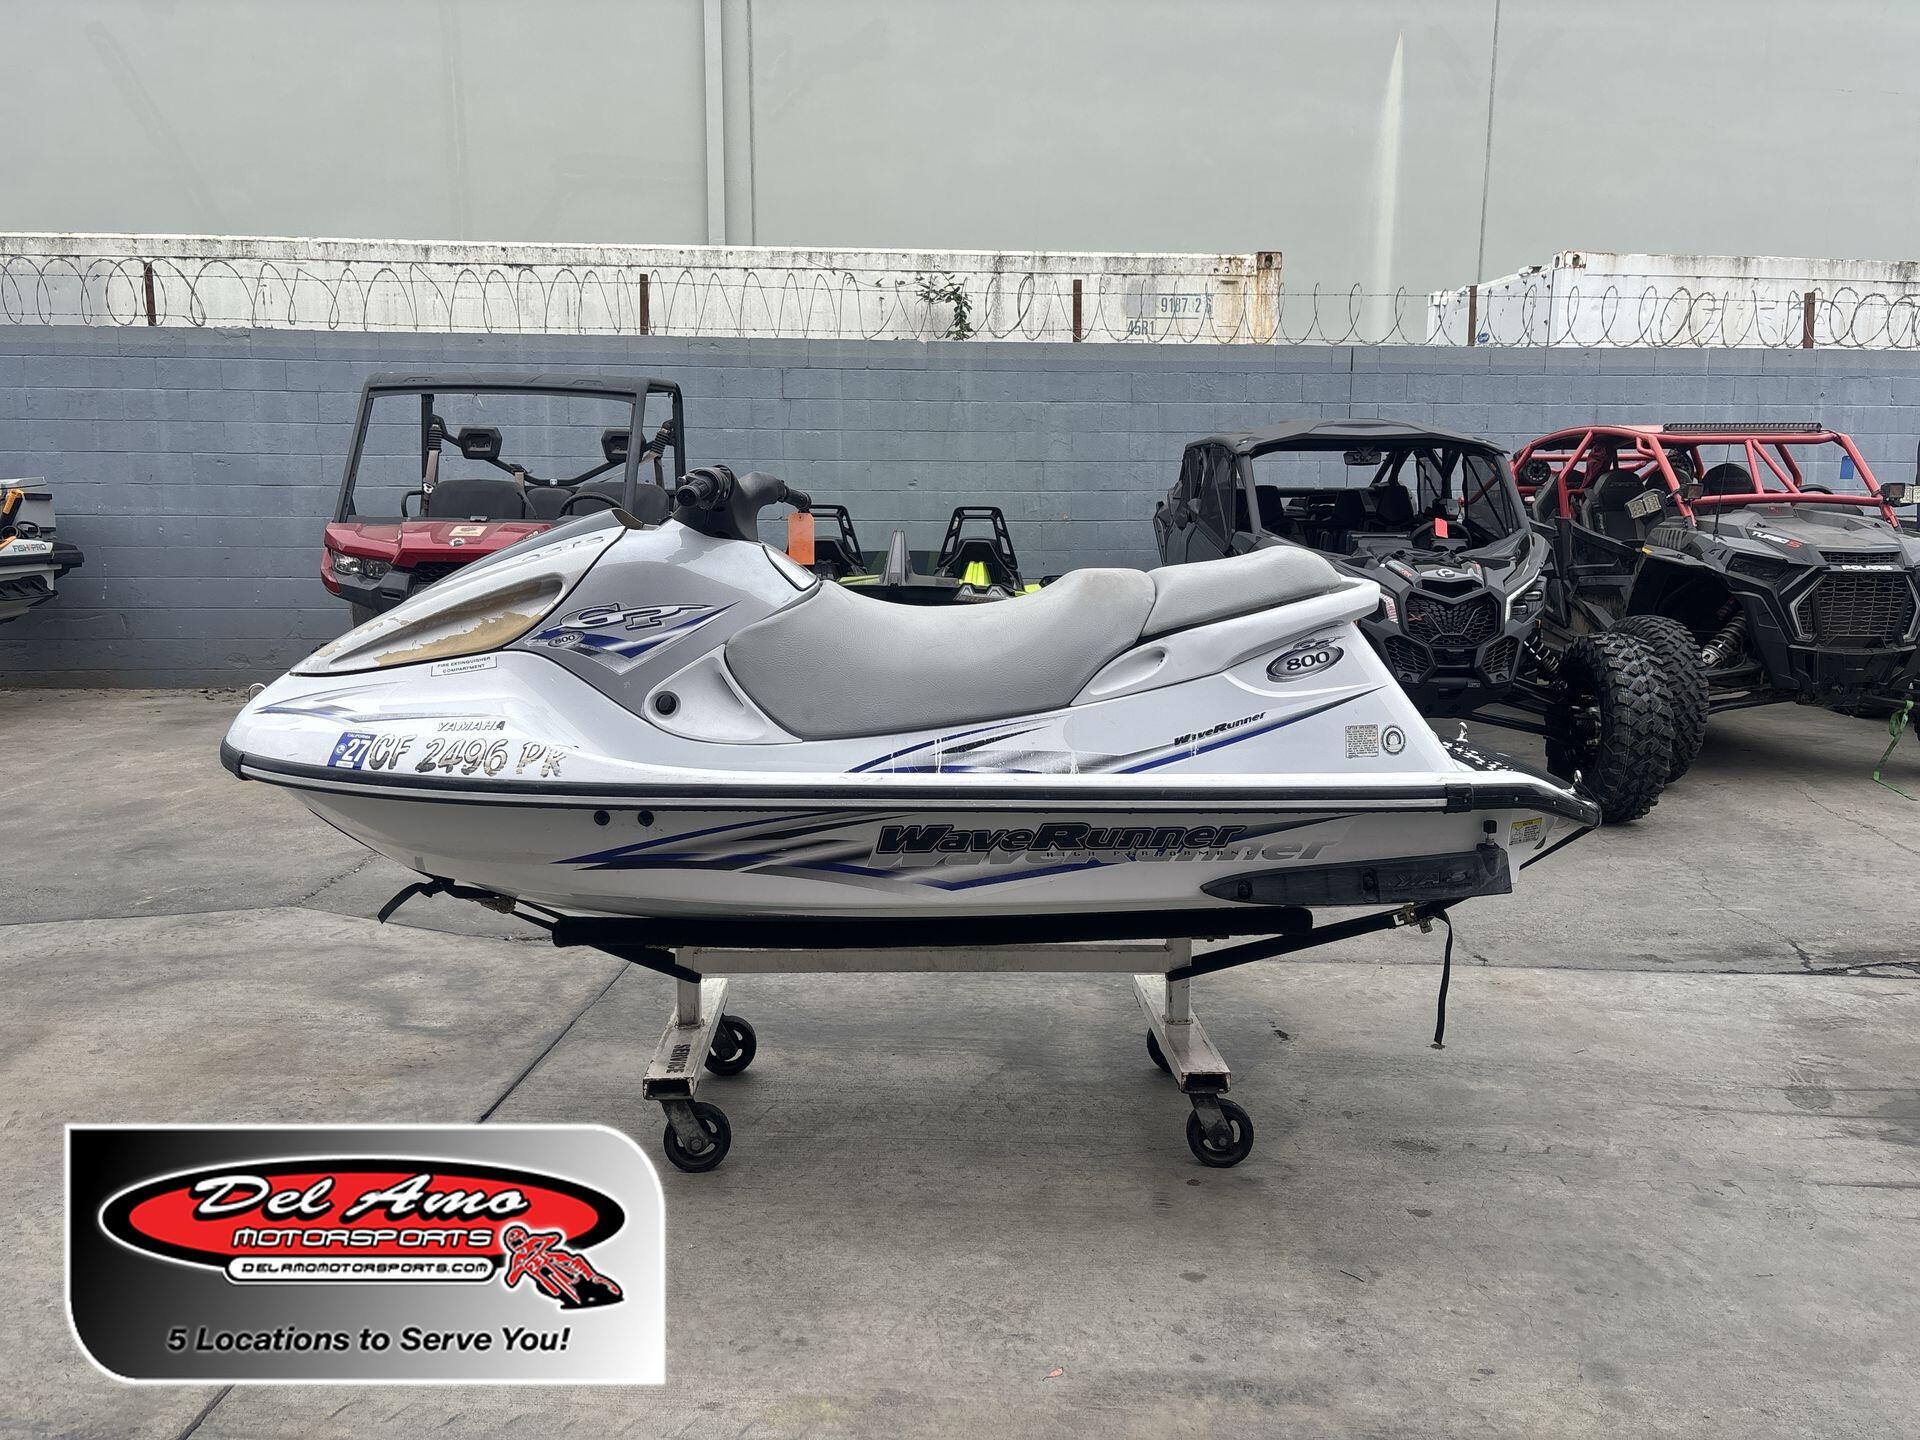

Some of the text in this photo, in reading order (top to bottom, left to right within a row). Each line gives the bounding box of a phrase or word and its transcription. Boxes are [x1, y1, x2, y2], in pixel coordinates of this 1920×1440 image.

[1840, 564, 1894, 572] POLARIS
[554, 633, 576, 645] 800
[442, 663, 486, 673] COMPARTMENT
[1286, 650, 1331, 672] 800
[437, 720, 506, 732] YAMAHA
[1174, 711, 1267, 746] WaveRunner
[341, 738, 372, 762] 27
[369, 733, 418, 771] CF
[415, 738, 509, 777] 2496
[877, 822, 1248, 853] WaveRunner
